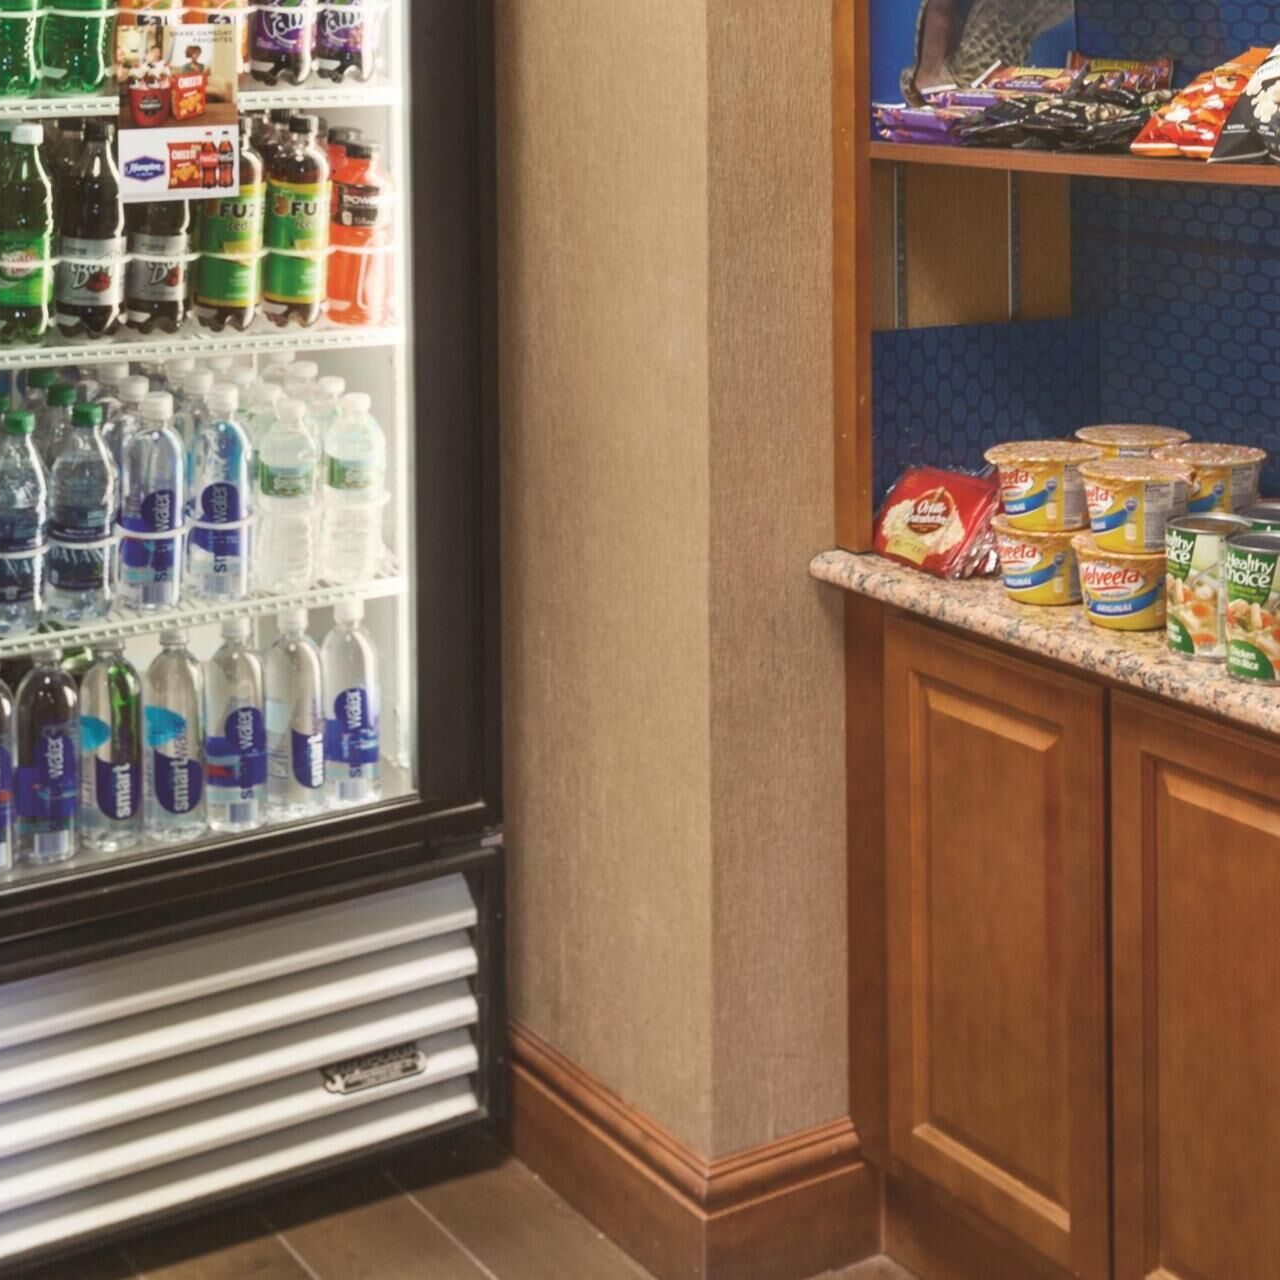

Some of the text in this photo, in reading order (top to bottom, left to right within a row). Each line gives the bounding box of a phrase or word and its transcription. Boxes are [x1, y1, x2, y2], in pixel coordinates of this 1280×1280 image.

[198, 29, 233, 37] GAMEDAY
[1081, 565, 1141, 585] Velveeta
[1226, 552, 1275, 575] Healthy
[1229, 645, 1257, 660] Chicken
[238, 709, 254, 749] water
[48, 736, 64, 779] water
[307, 733, 324, 787] smart
[113, 762, 132, 819] smart
